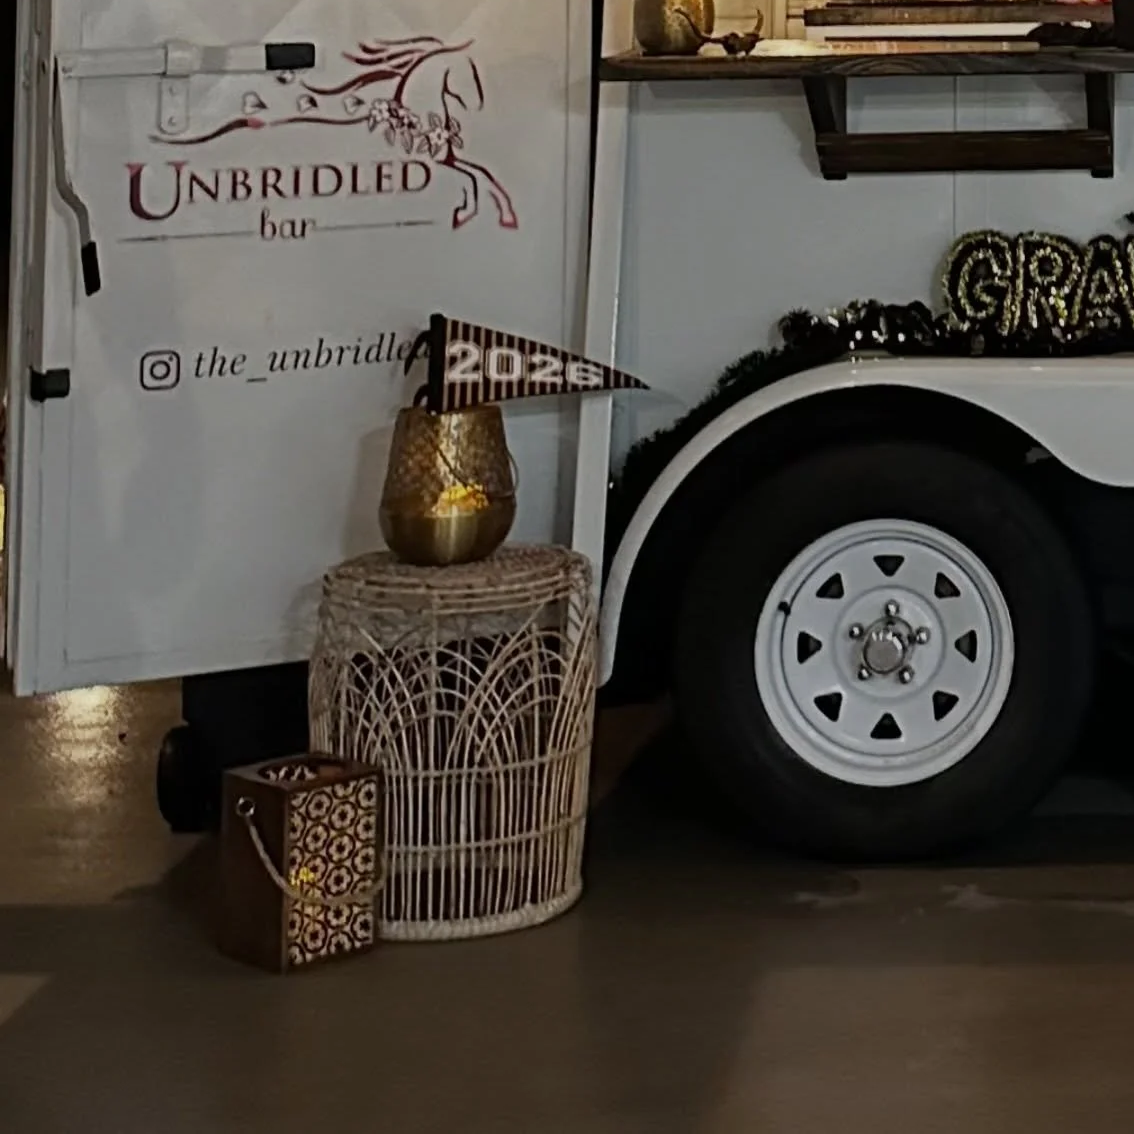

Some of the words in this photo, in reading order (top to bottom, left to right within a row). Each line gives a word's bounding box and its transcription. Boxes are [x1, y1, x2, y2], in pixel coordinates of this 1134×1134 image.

[124, 159, 432, 221] UNBRIDLED
[260, 207, 316, 241] bar
[194, 331, 429, 383] the_unbridle
[447, 340, 604, 388] 2026
